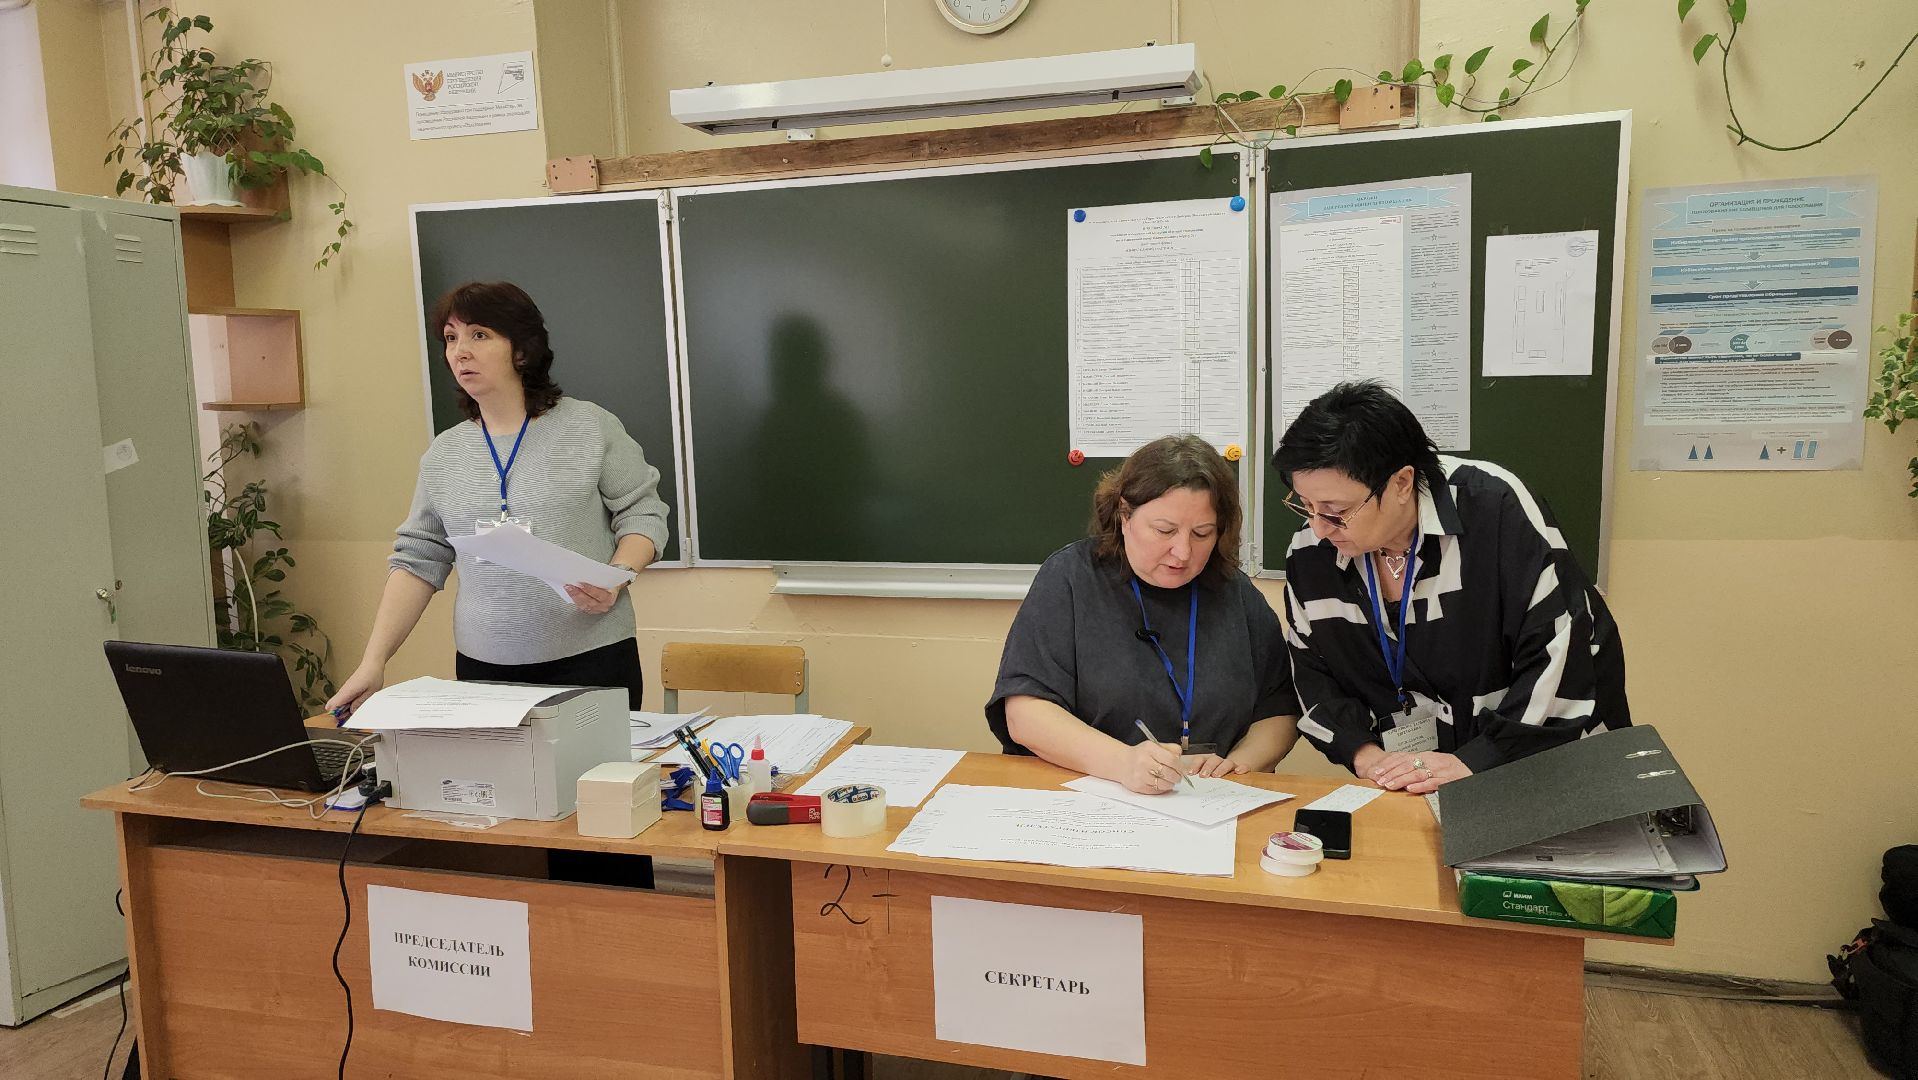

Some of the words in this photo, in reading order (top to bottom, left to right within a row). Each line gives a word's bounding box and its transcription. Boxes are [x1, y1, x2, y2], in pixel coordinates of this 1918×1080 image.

[125, 663, 162, 675] lenovo
[1502, 900, 1550, 914] Стандарт
[394, 932, 505, 957] ПРЕДСЕДАТЕЛЬ
[408, 955, 491, 977] КОМИССИИ
[984, 970, 1090, 995] СЕКРЕТАРЬ
